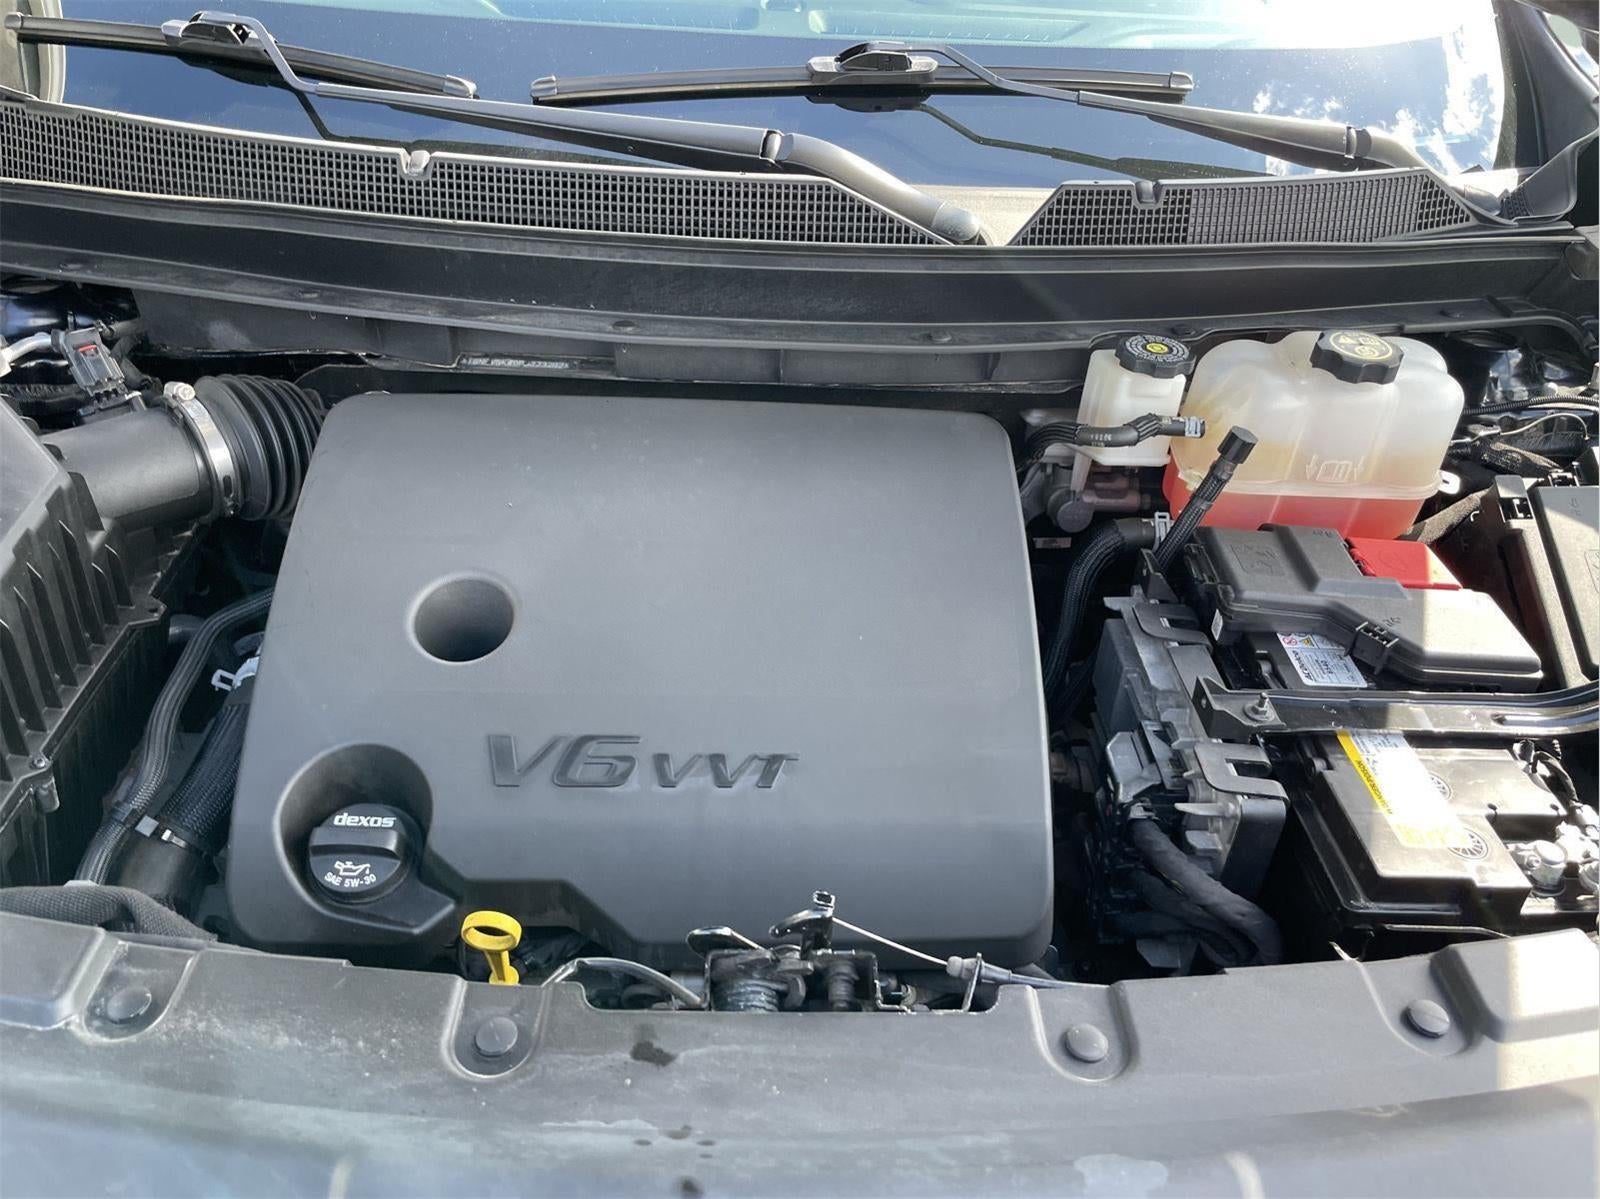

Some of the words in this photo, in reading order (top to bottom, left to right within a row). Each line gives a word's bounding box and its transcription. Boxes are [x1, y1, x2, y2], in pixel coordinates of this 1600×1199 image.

[487, 733, 641, 788] V6
[652, 752, 800, 789] VVT
[333, 812, 397, 828] dexos
[324, 871, 343, 886] SAE
[344, 874, 377, 888] 5W-30
